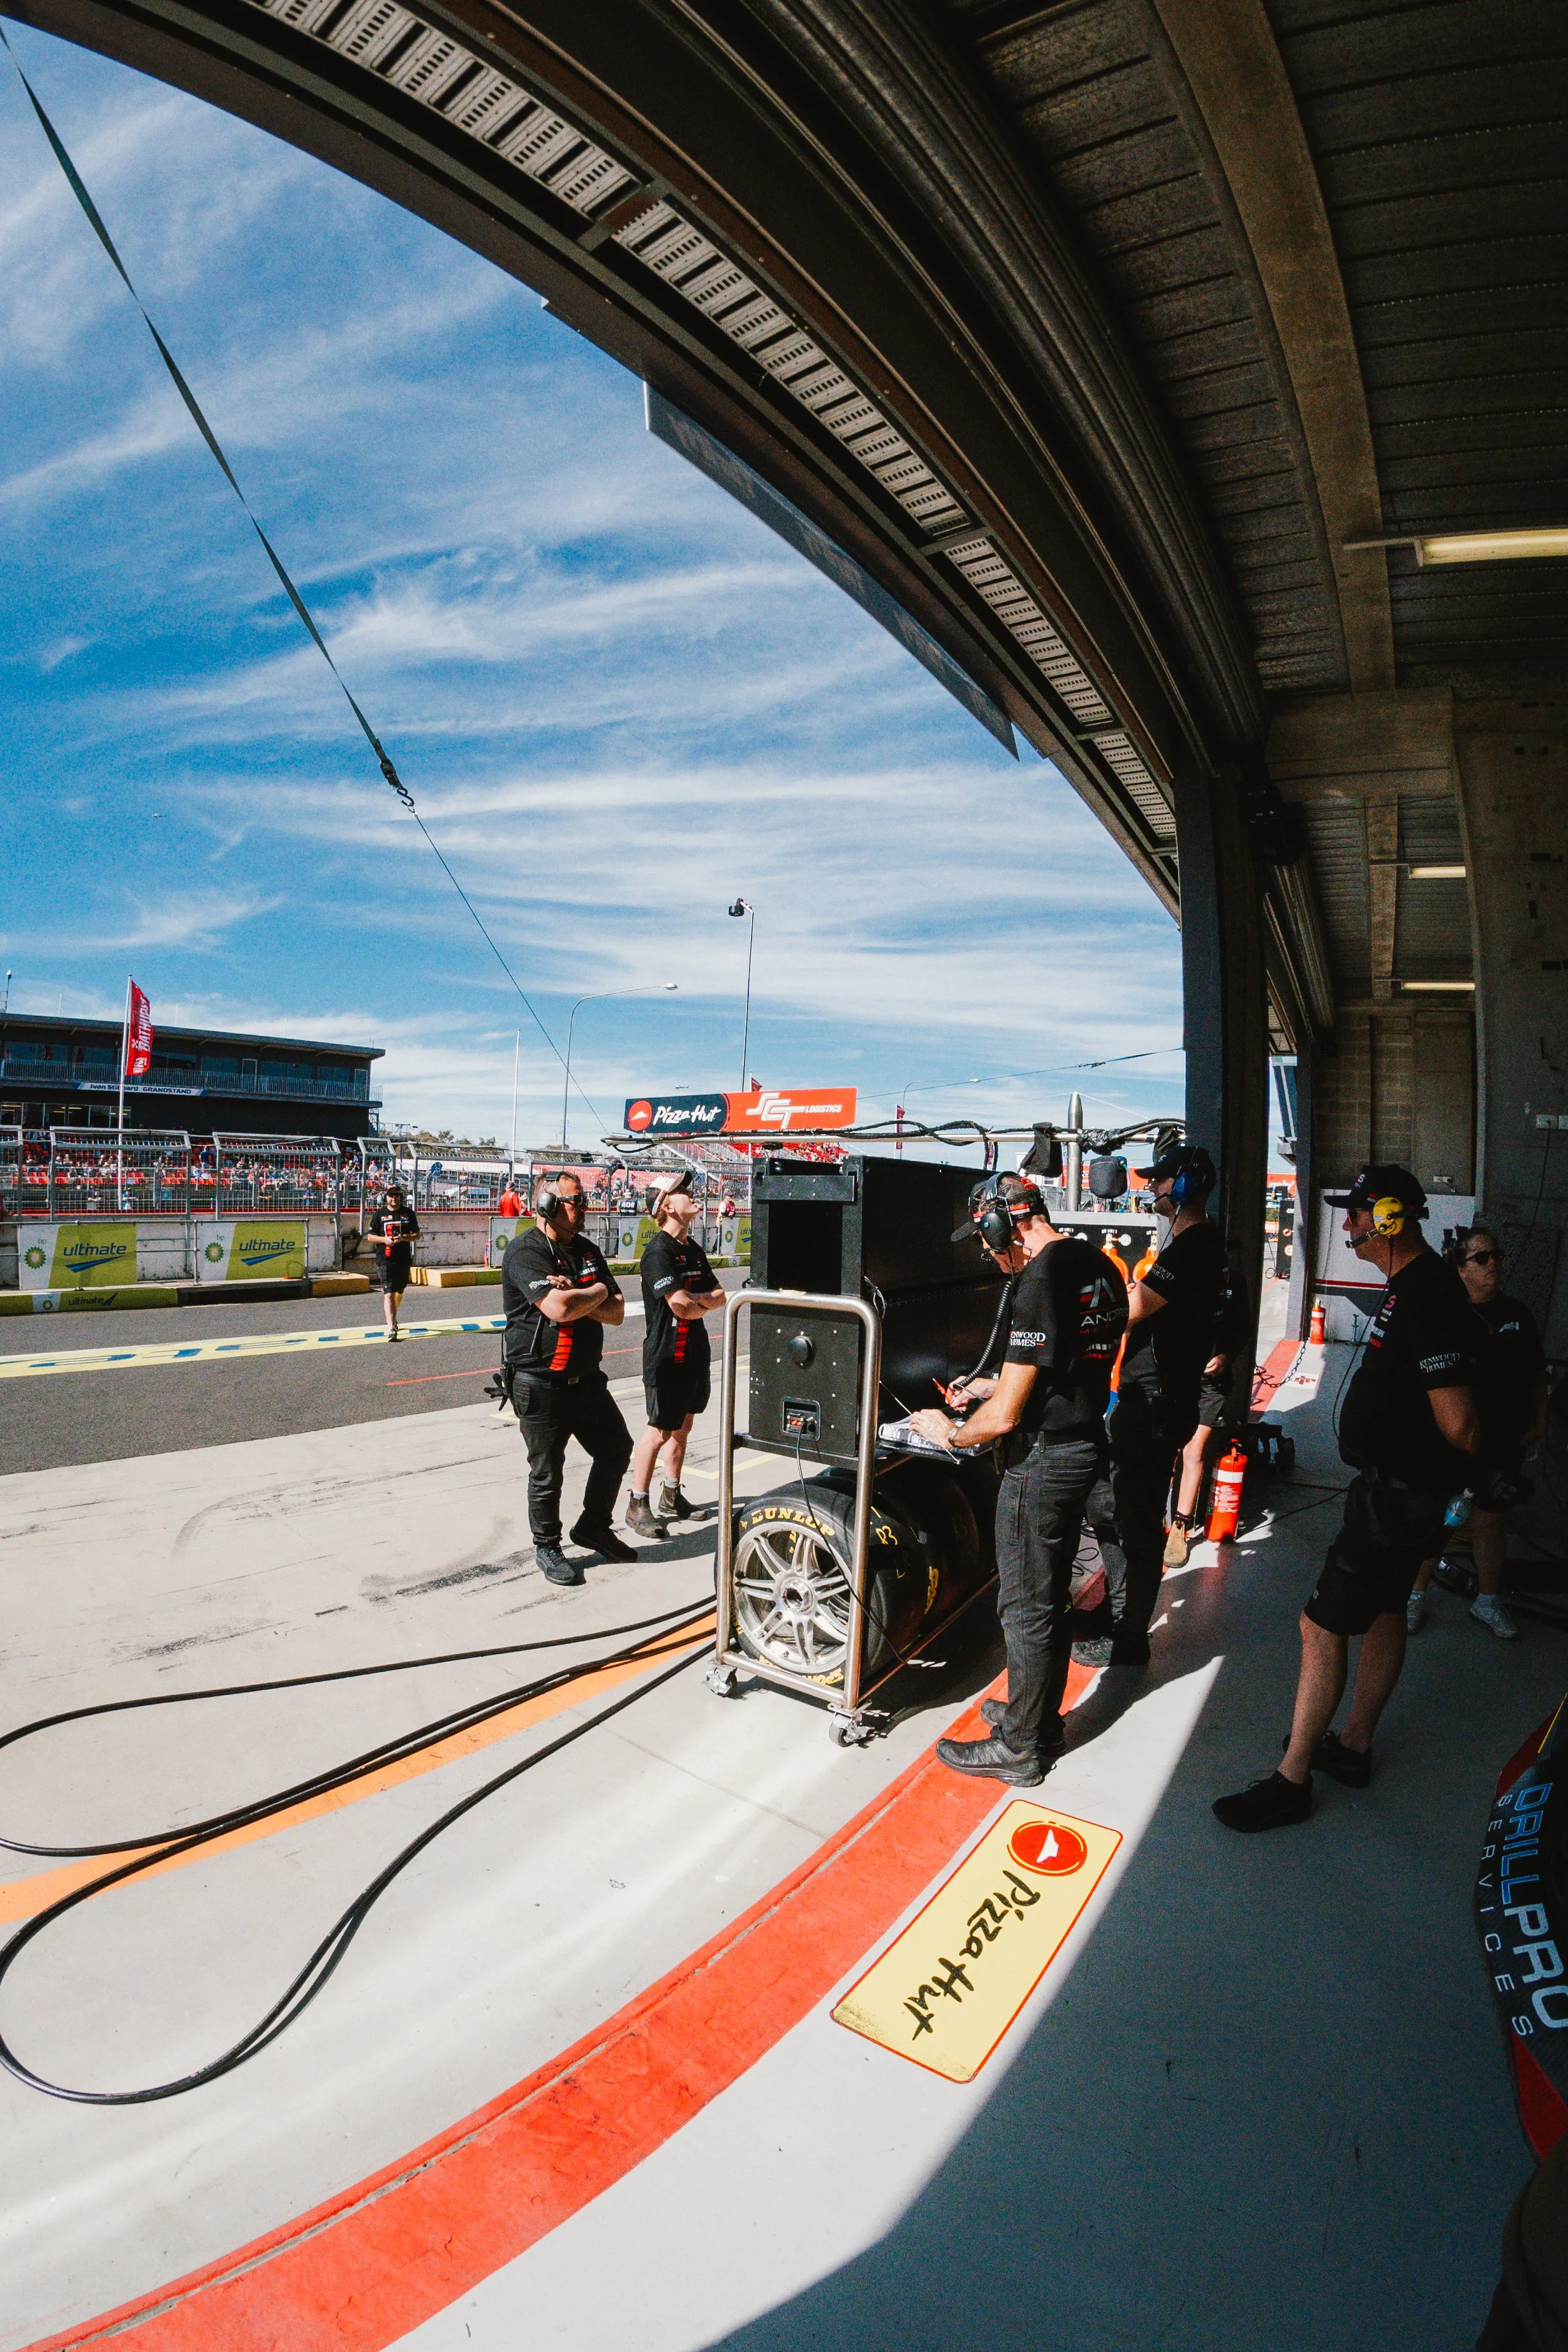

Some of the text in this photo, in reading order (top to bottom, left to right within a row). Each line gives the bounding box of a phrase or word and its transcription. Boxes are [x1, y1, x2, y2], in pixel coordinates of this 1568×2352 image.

[653, 1105, 722, 1126] Pizza Hut
[804, 1104, 843, 1114] LOGISTICS
[63, 1242, 127, 1256] ultimate
[239, 1238, 295, 1252] ultimate
[68, 1296, 105, 1306] ultimate
[1419, 1352, 1460, 1370] KENWOOD
[1426, 1360, 1454, 1373] HOMES
[751, 1507, 835, 1536] DUNLOP
[1500, 1782, 1568, 2029] DRILLPRO
[1477, 1793, 1534, 2038] SERVICES
[903, 1870, 1041, 2041] Pizza Hut
